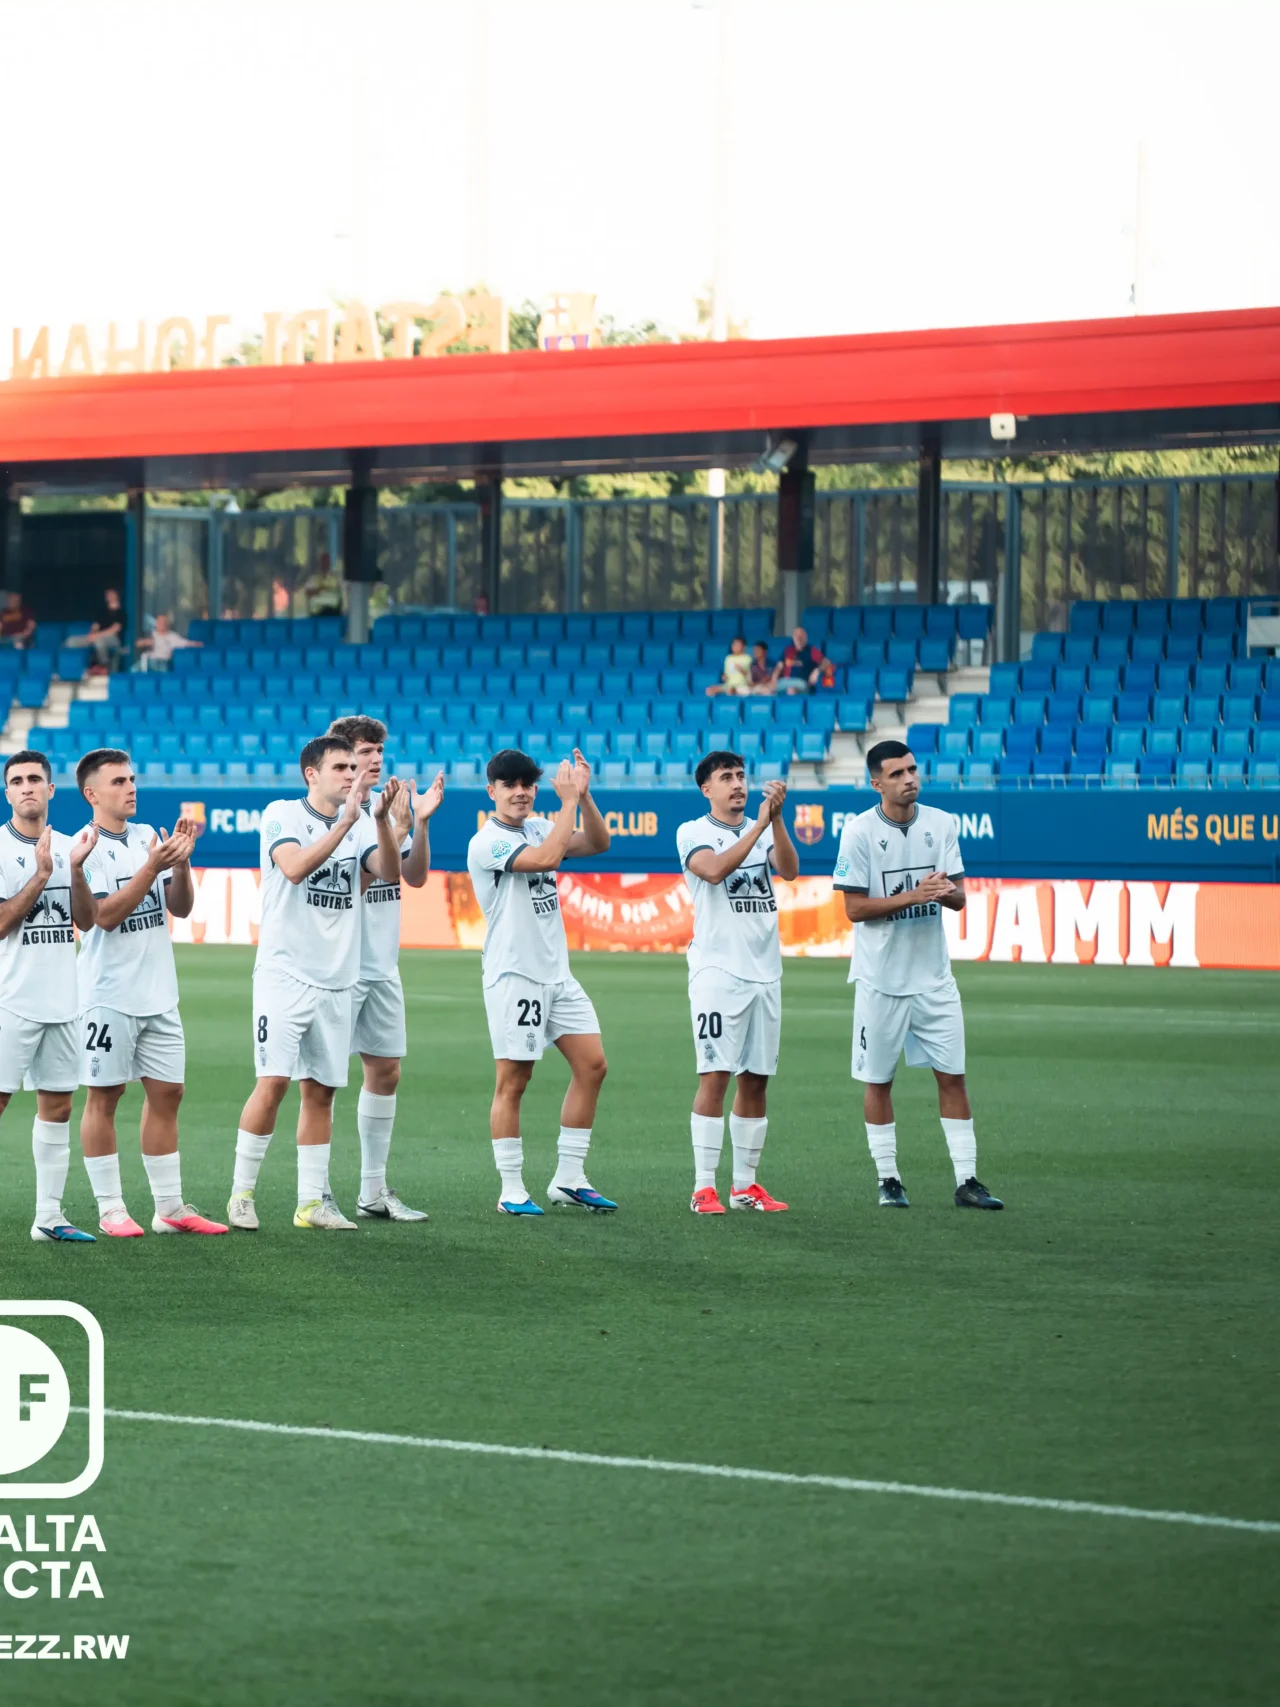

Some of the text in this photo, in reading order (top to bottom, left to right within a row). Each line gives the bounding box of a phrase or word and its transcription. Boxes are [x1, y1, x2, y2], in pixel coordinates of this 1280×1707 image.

[605, 811, 658, 836] CLUB
[1147, 807, 1199, 840] MÉS
[1205, 814, 1255, 846] QUE
[365, 888, 401, 904] GUIRRE
[532, 897, 558, 915] GUIR
[120, 913, 165, 934] AGUIRRE
[22, 928, 75, 946] AGUIRRE
[516, 998, 541, 1027] 23
[697, 1011, 722, 1039] 20
[85, 1022, 113, 1053] 24
[257, 1015, 269, 1043] 8
